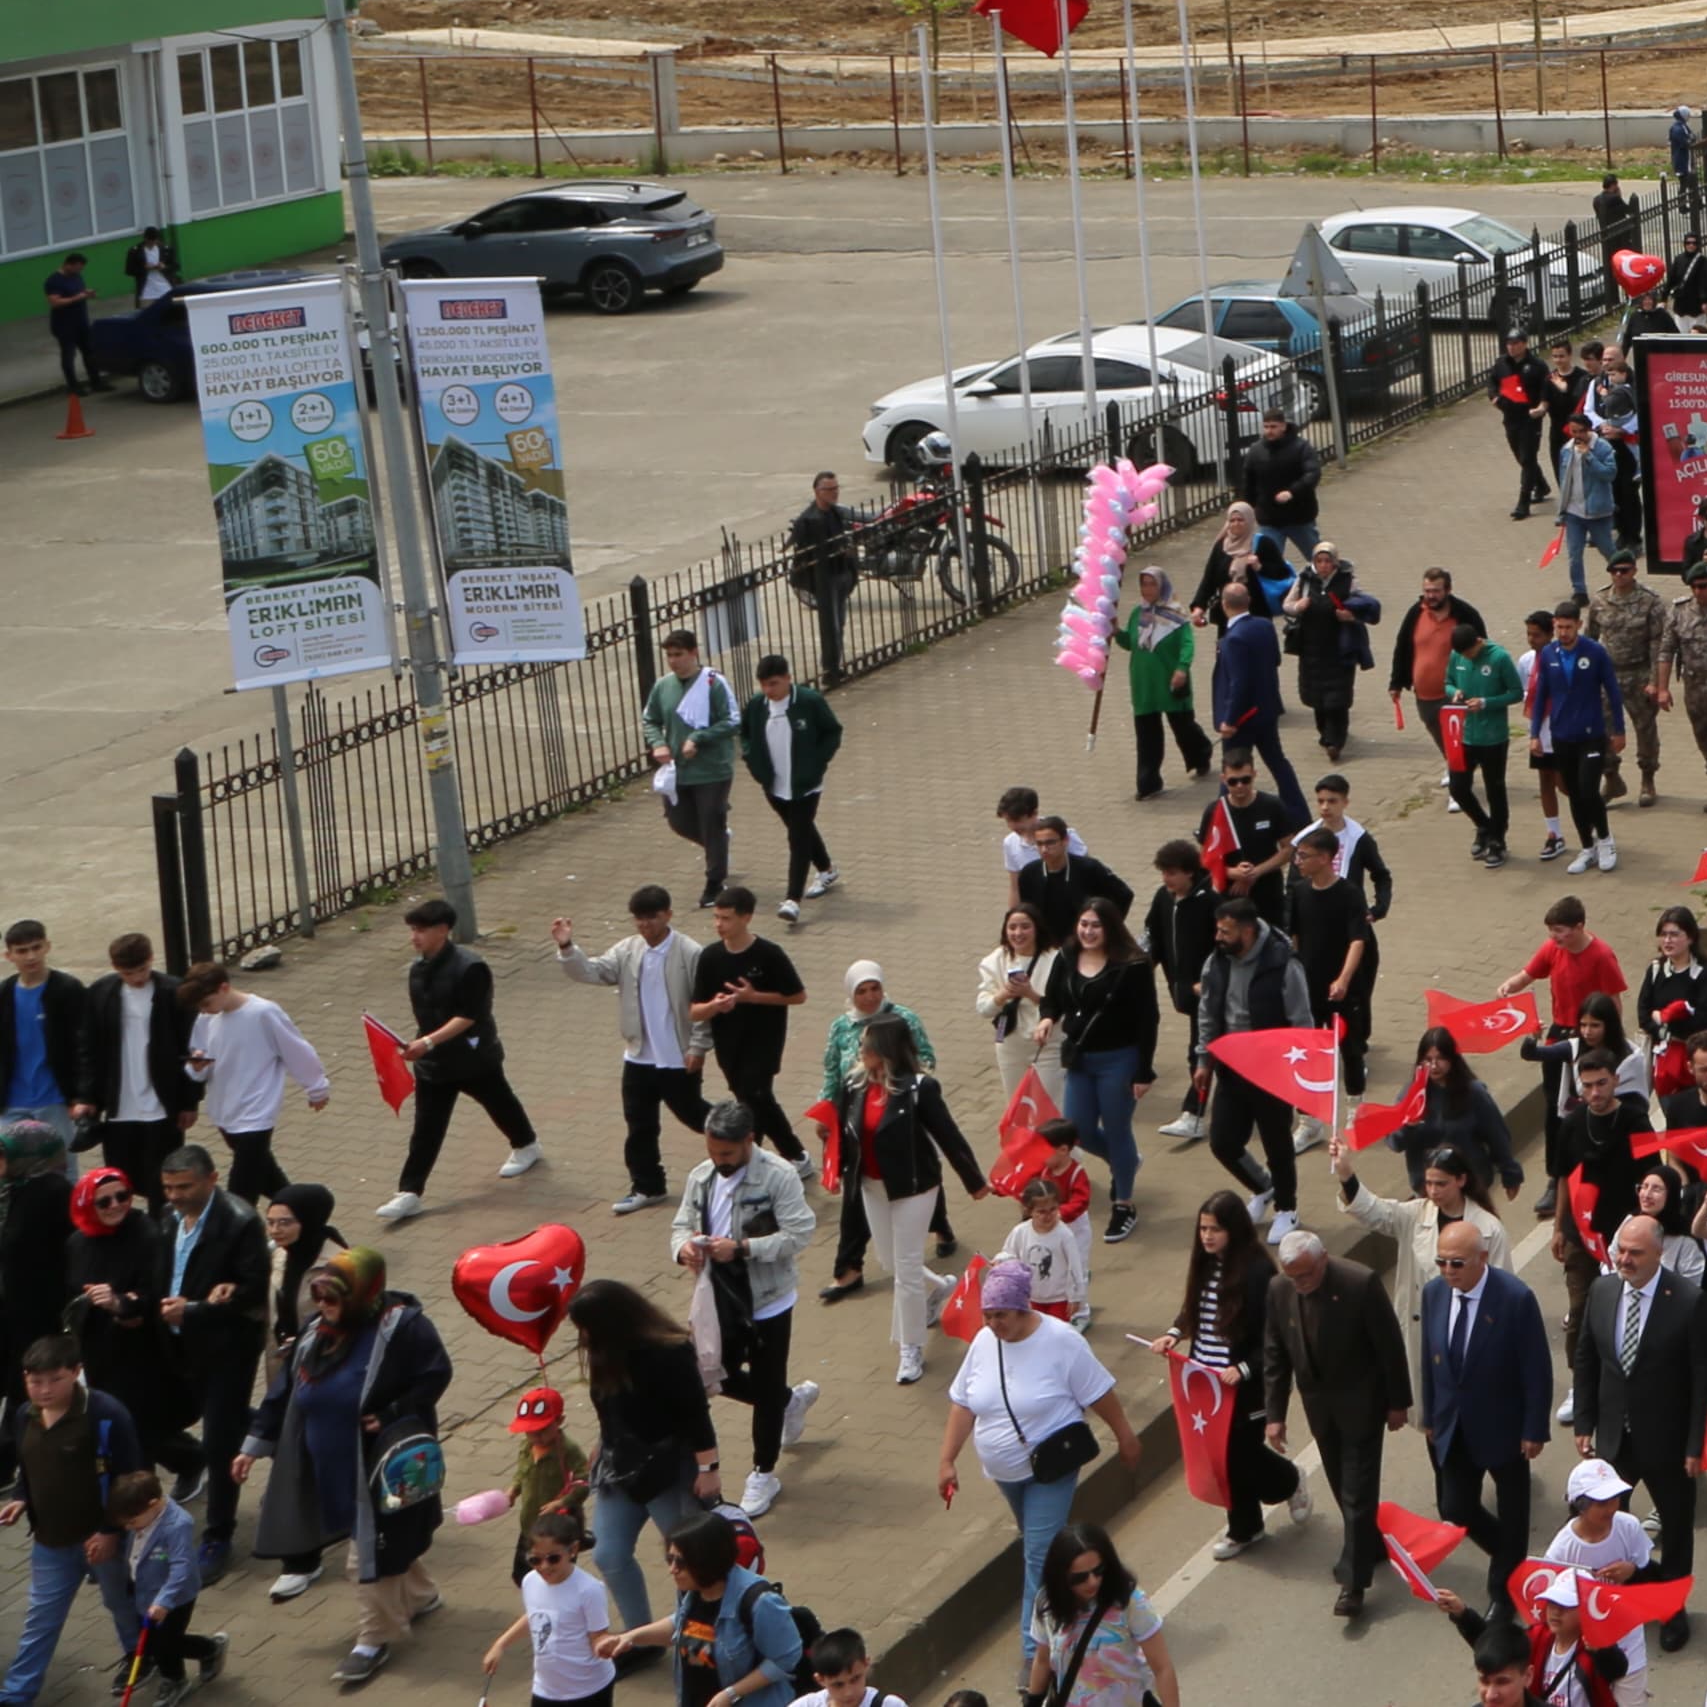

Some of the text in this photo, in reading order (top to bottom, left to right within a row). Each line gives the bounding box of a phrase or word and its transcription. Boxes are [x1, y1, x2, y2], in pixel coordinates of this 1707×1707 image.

[473, 325, 485, 335] TL
[201, 339, 260, 354] 600.000
[262, 337, 278, 348] TL
[203, 354, 247, 369] 25.000
[251, 352, 263, 363] TL
[324, 344, 340, 355] EV
[420, 362, 543, 379] HAYAT BAŞLIYOR
[206, 370, 345, 397] HAYAT BAŞLIYOR
[1674, 385, 1687, 396] 24
[446, 394, 472, 406] 3+1
[500, 392, 526, 404] 4+1
[238, 408, 263, 422] 1+1
[298, 401, 326, 415] 2+1
[316, 458, 350, 473] VADE
[461, 574, 512, 585] BEREKET
[246, 588, 306, 605] BEREKET
[466, 603, 518, 614] MODERN
[250, 622, 299, 639] LOFT
